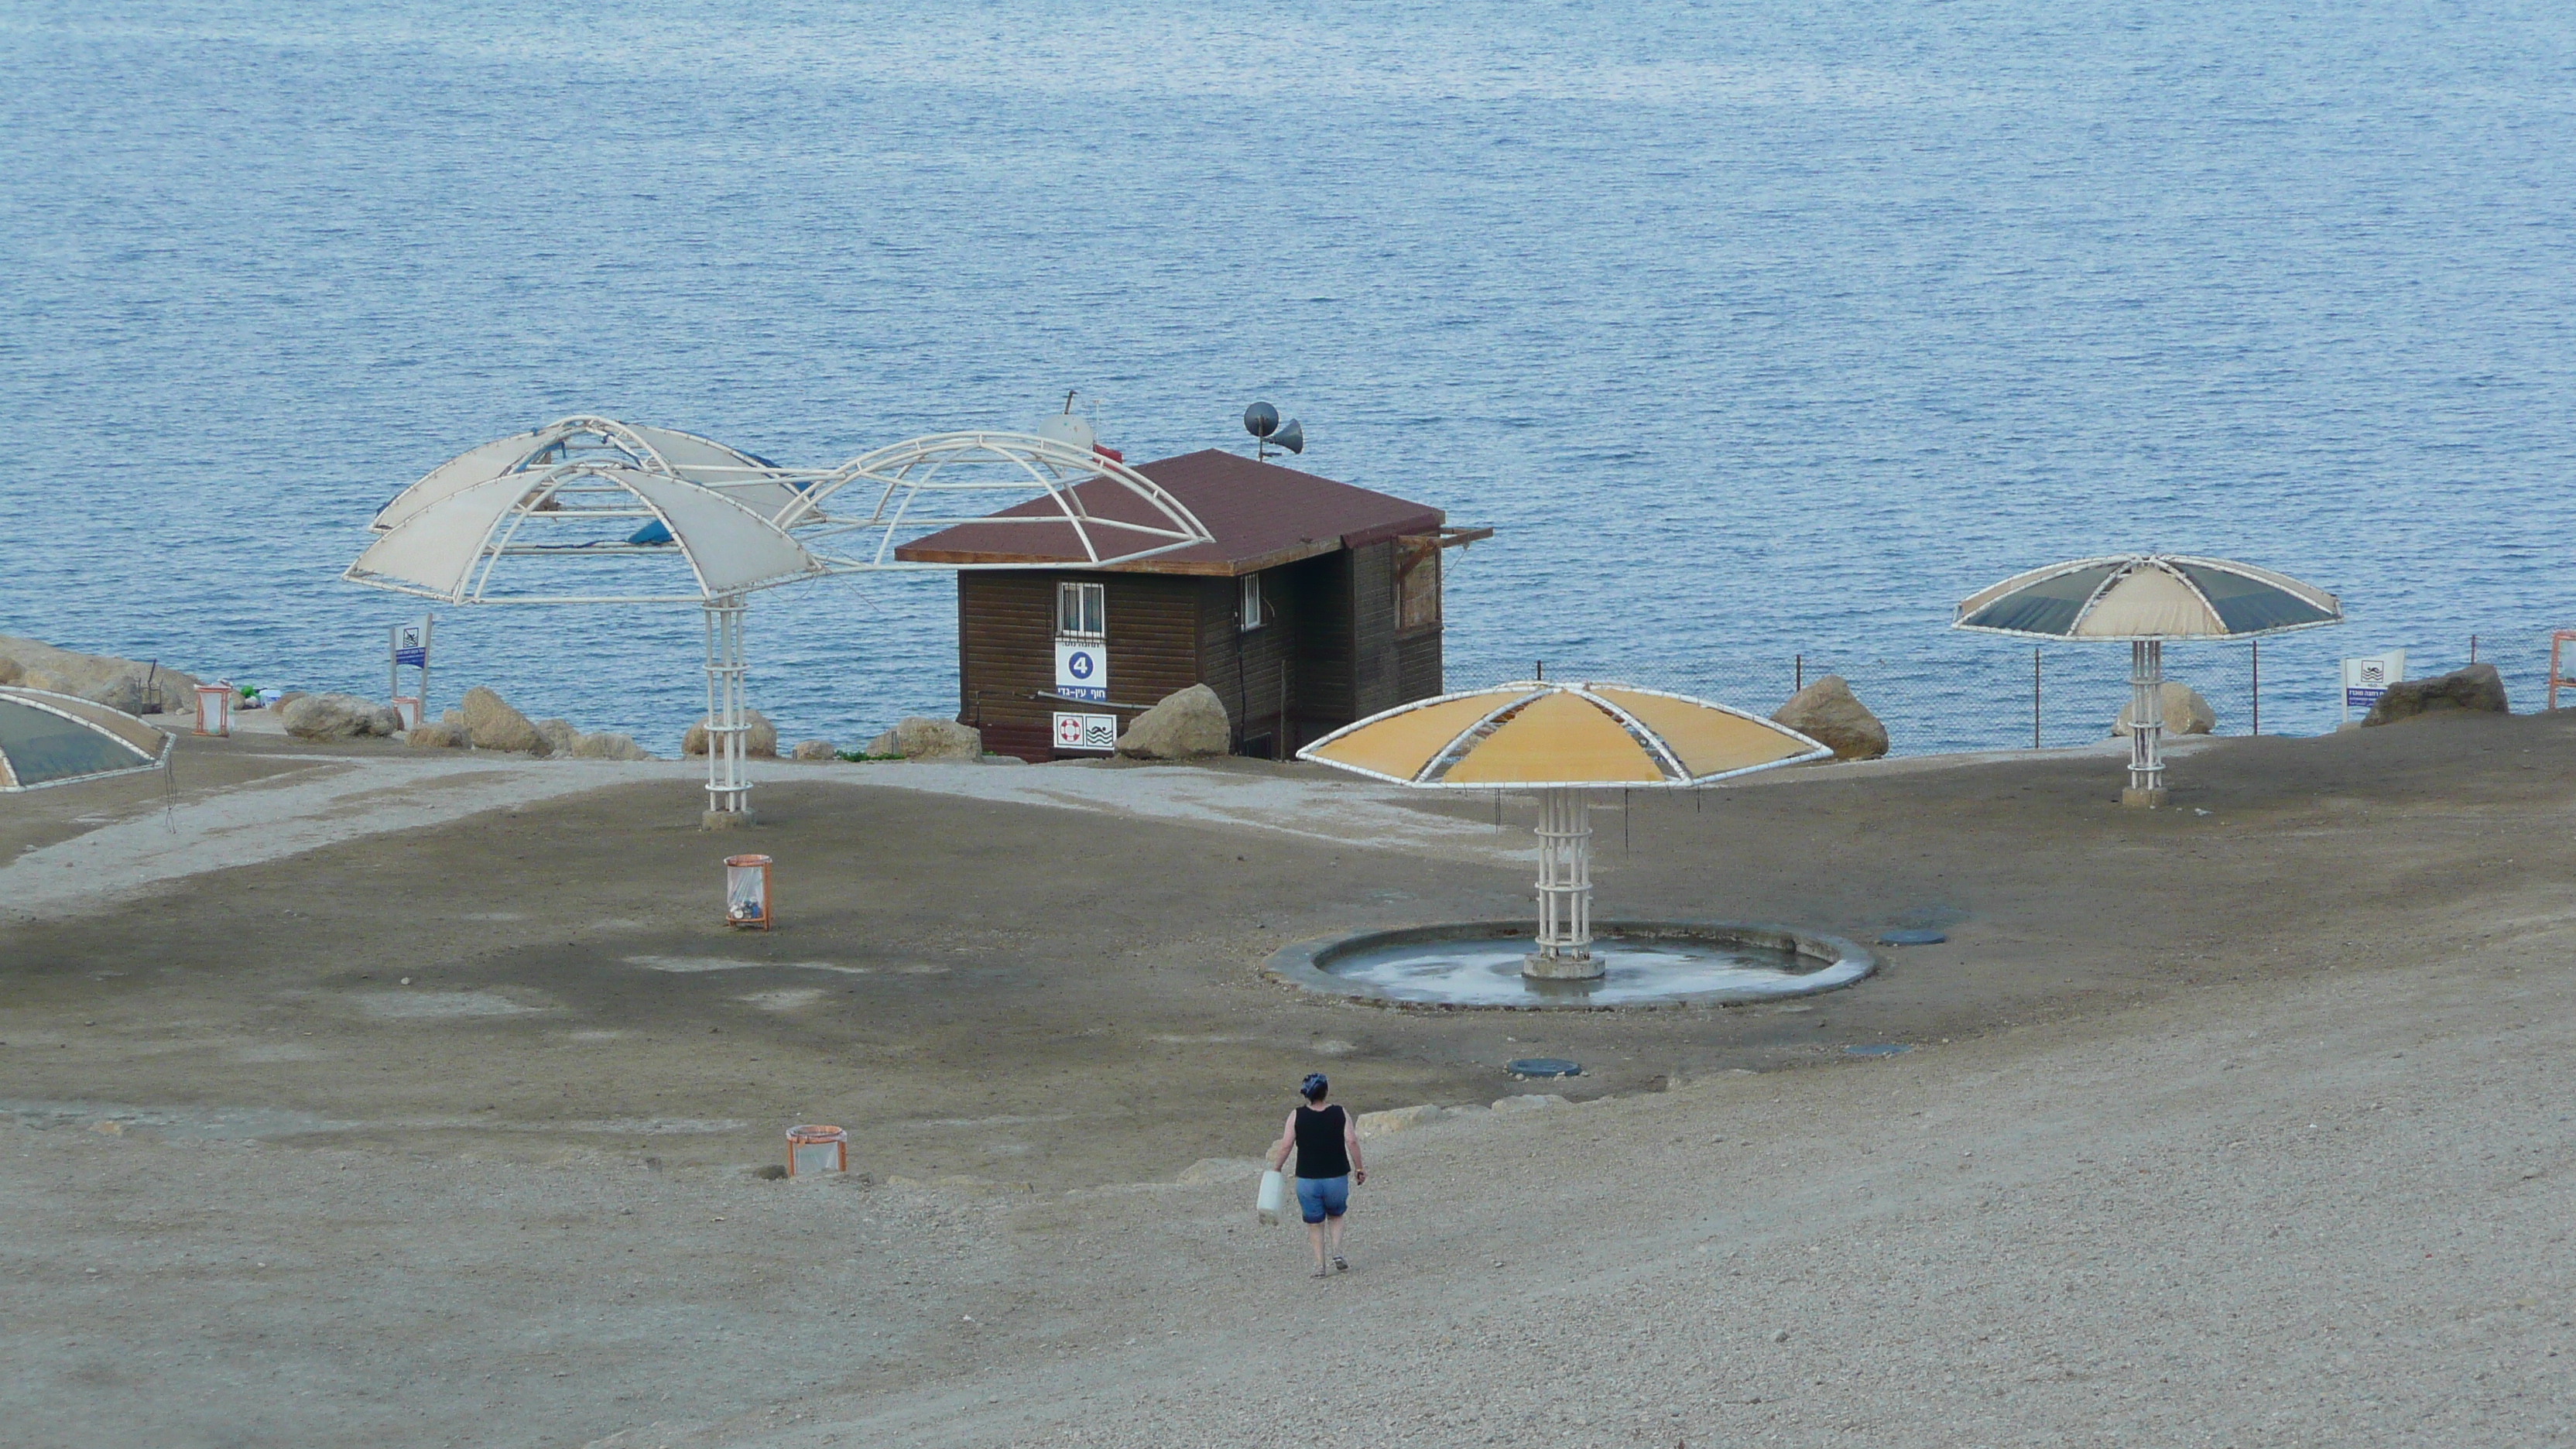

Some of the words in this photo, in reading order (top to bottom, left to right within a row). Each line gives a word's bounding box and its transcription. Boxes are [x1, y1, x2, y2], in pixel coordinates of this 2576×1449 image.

[1074, 656, 1088, 674] 4
[1057, 687, 1086, 699] עין-גדי
[1091, 689, 1105, 700] חוף
